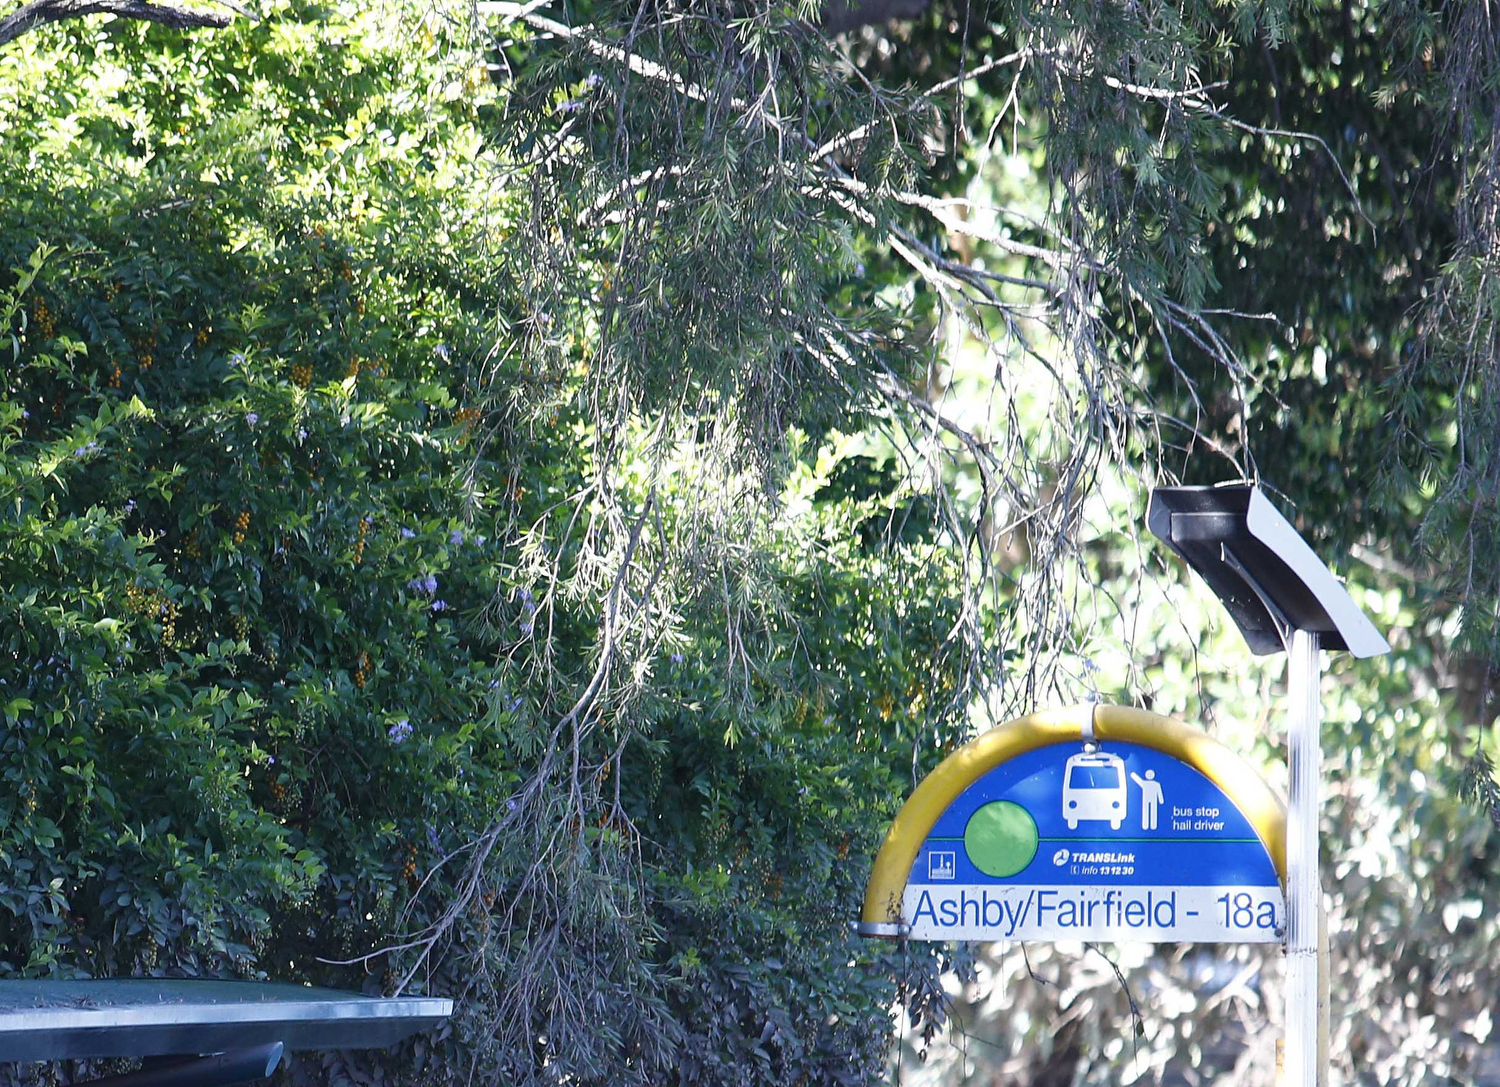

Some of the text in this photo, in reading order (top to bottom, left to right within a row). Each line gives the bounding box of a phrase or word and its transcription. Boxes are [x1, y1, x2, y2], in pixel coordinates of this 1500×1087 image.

[1173, 806, 1219, 819] bus stop
[1173, 820, 1225, 830] hail driver
[1081, 865, 1098, 875] info
[911, 890, 1176, 937] Ashby/Fairfield
[1218, 892, 1277, 929] 18a
